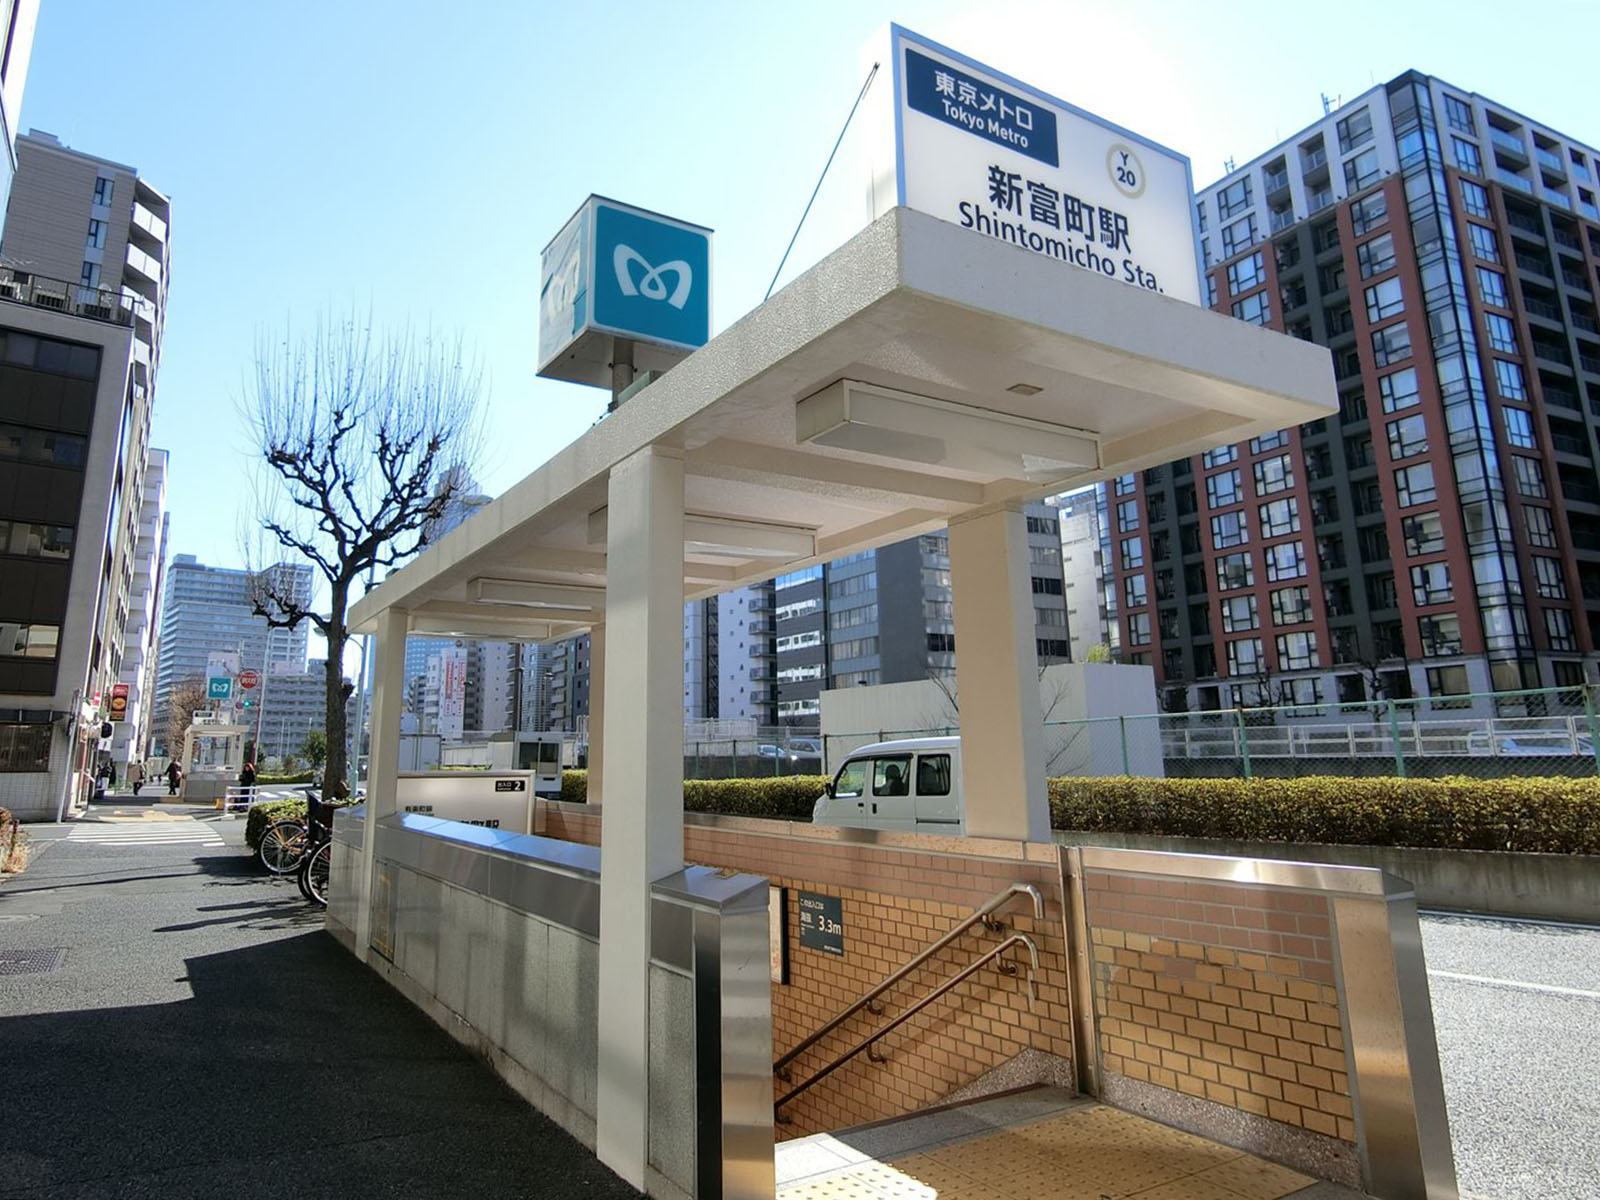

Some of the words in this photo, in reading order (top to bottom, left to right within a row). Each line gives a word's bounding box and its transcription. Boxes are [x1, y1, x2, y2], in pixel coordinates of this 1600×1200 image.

[934, 70, 1033, 131] 東京メトロ
[942, 98, 985, 129] Tokyo
[988, 118, 1029, 148] Metro
[1118, 151, 1129, 166] Y
[1116, 166, 1136, 187] 20
[988, 164, 1131, 254] 新富町駅
[959, 201, 1115, 277] Shintomicho
[1122, 259, 1164, 293] Sta.
[514, 781, 521, 791] 2
[818, 915, 842, 936] 3.3m
